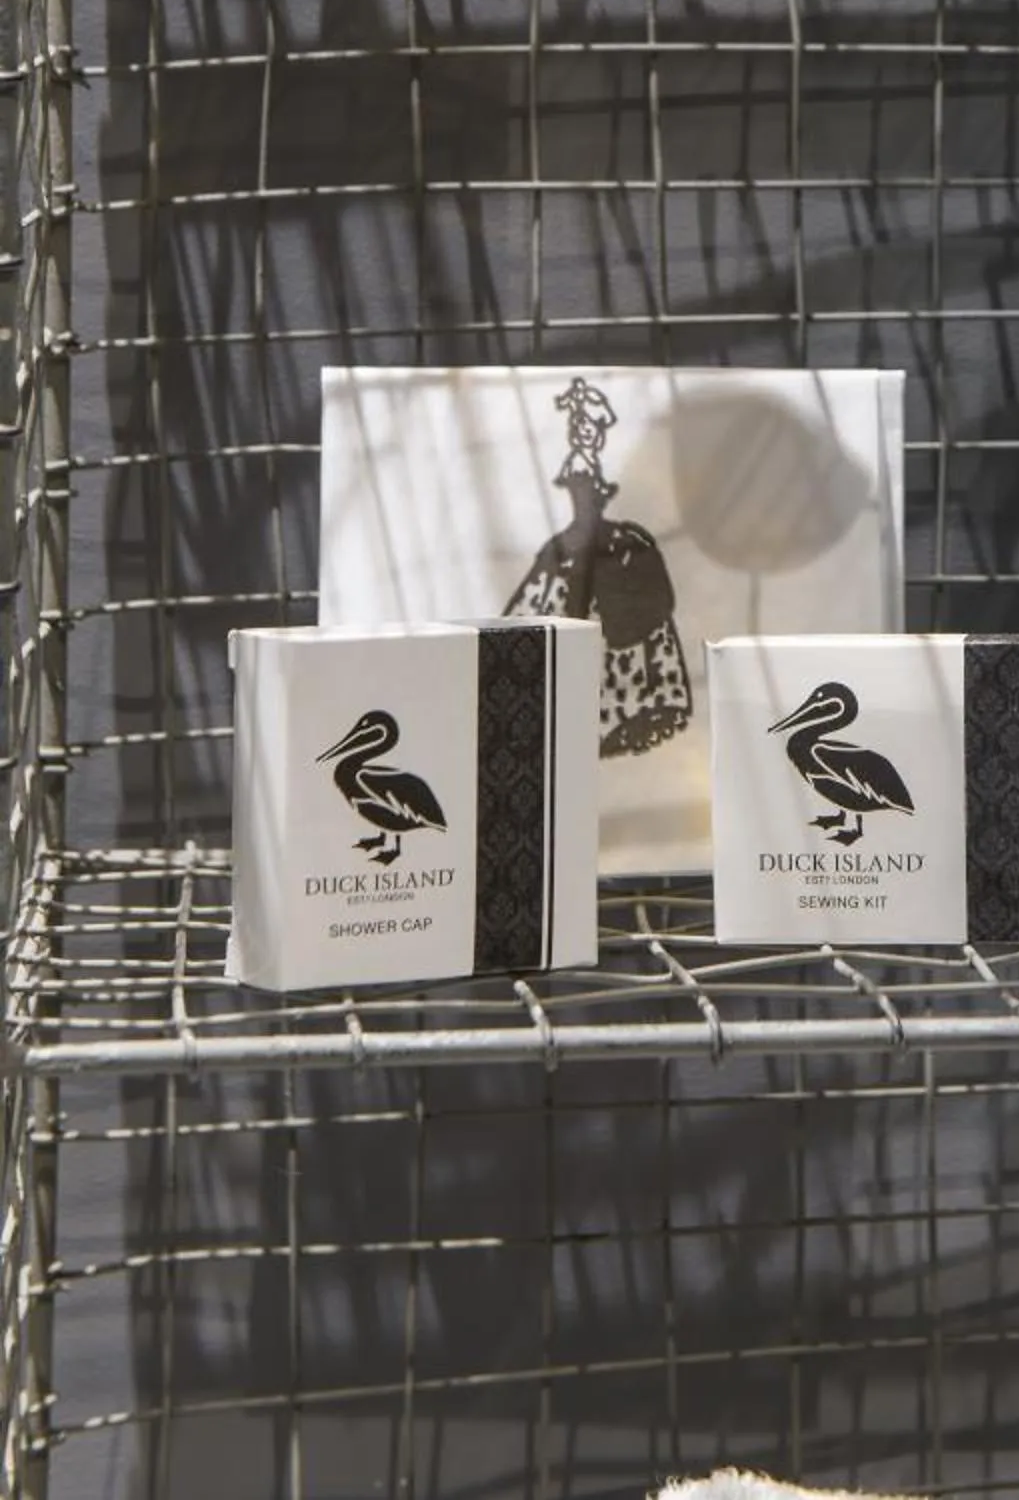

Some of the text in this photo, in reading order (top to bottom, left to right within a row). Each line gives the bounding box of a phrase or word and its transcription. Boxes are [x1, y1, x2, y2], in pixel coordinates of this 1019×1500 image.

[759, 853, 926, 873] DUCK ISLAND
[305, 868, 454, 896] DUCK ISLAND
[832, 875, 879, 885] LONDON
[799, 896, 888, 911] SEWING KIT
[329, 917, 433, 938] SHOWER CAP
